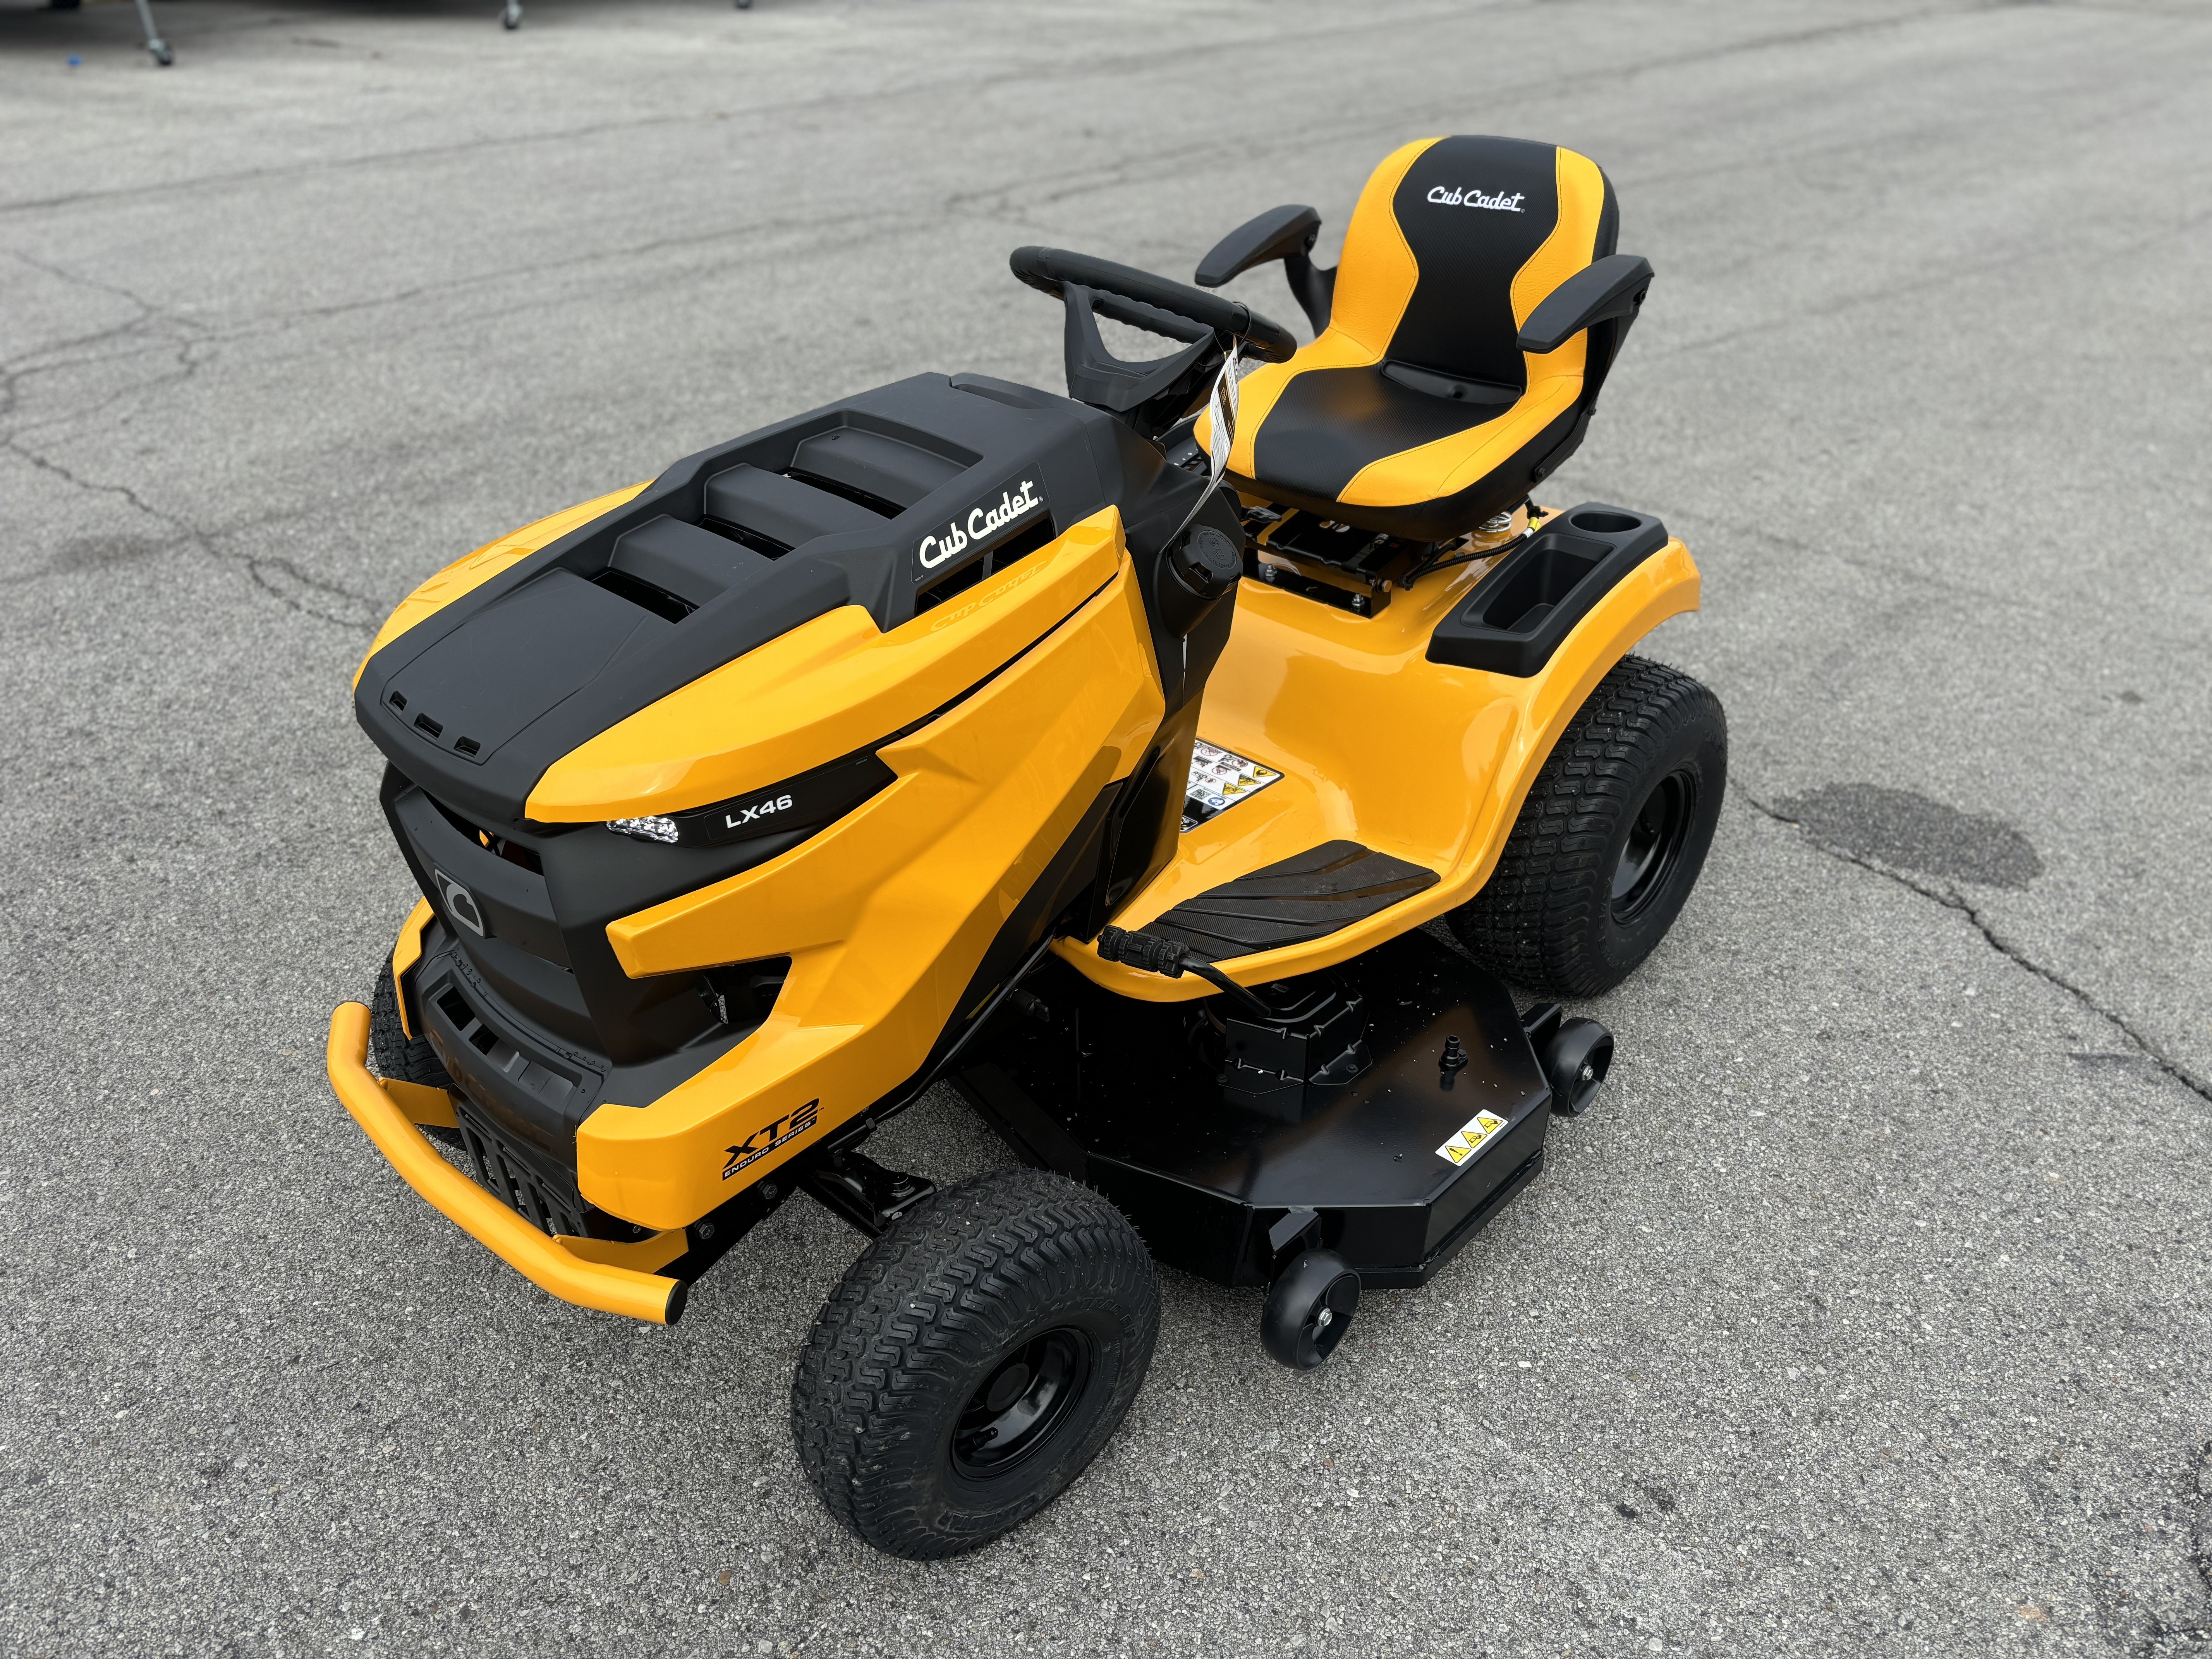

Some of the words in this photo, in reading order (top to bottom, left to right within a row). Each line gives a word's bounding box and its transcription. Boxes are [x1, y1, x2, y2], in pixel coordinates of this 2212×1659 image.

[1427, 186, 1462, 205] Cub
[1463, 190, 1525, 212] Cadet
[919, 522, 968, 568] Cub
[967, 480, 1039, 540] Cadet
[725, 794, 793, 829] LX46
[722, 1098, 819, 1170] XT2
[724, 1147, 769, 1177] ENDURO
[775, 1121, 811, 1146] SERIES
[1080, 1297, 1123, 1315] TRAC
